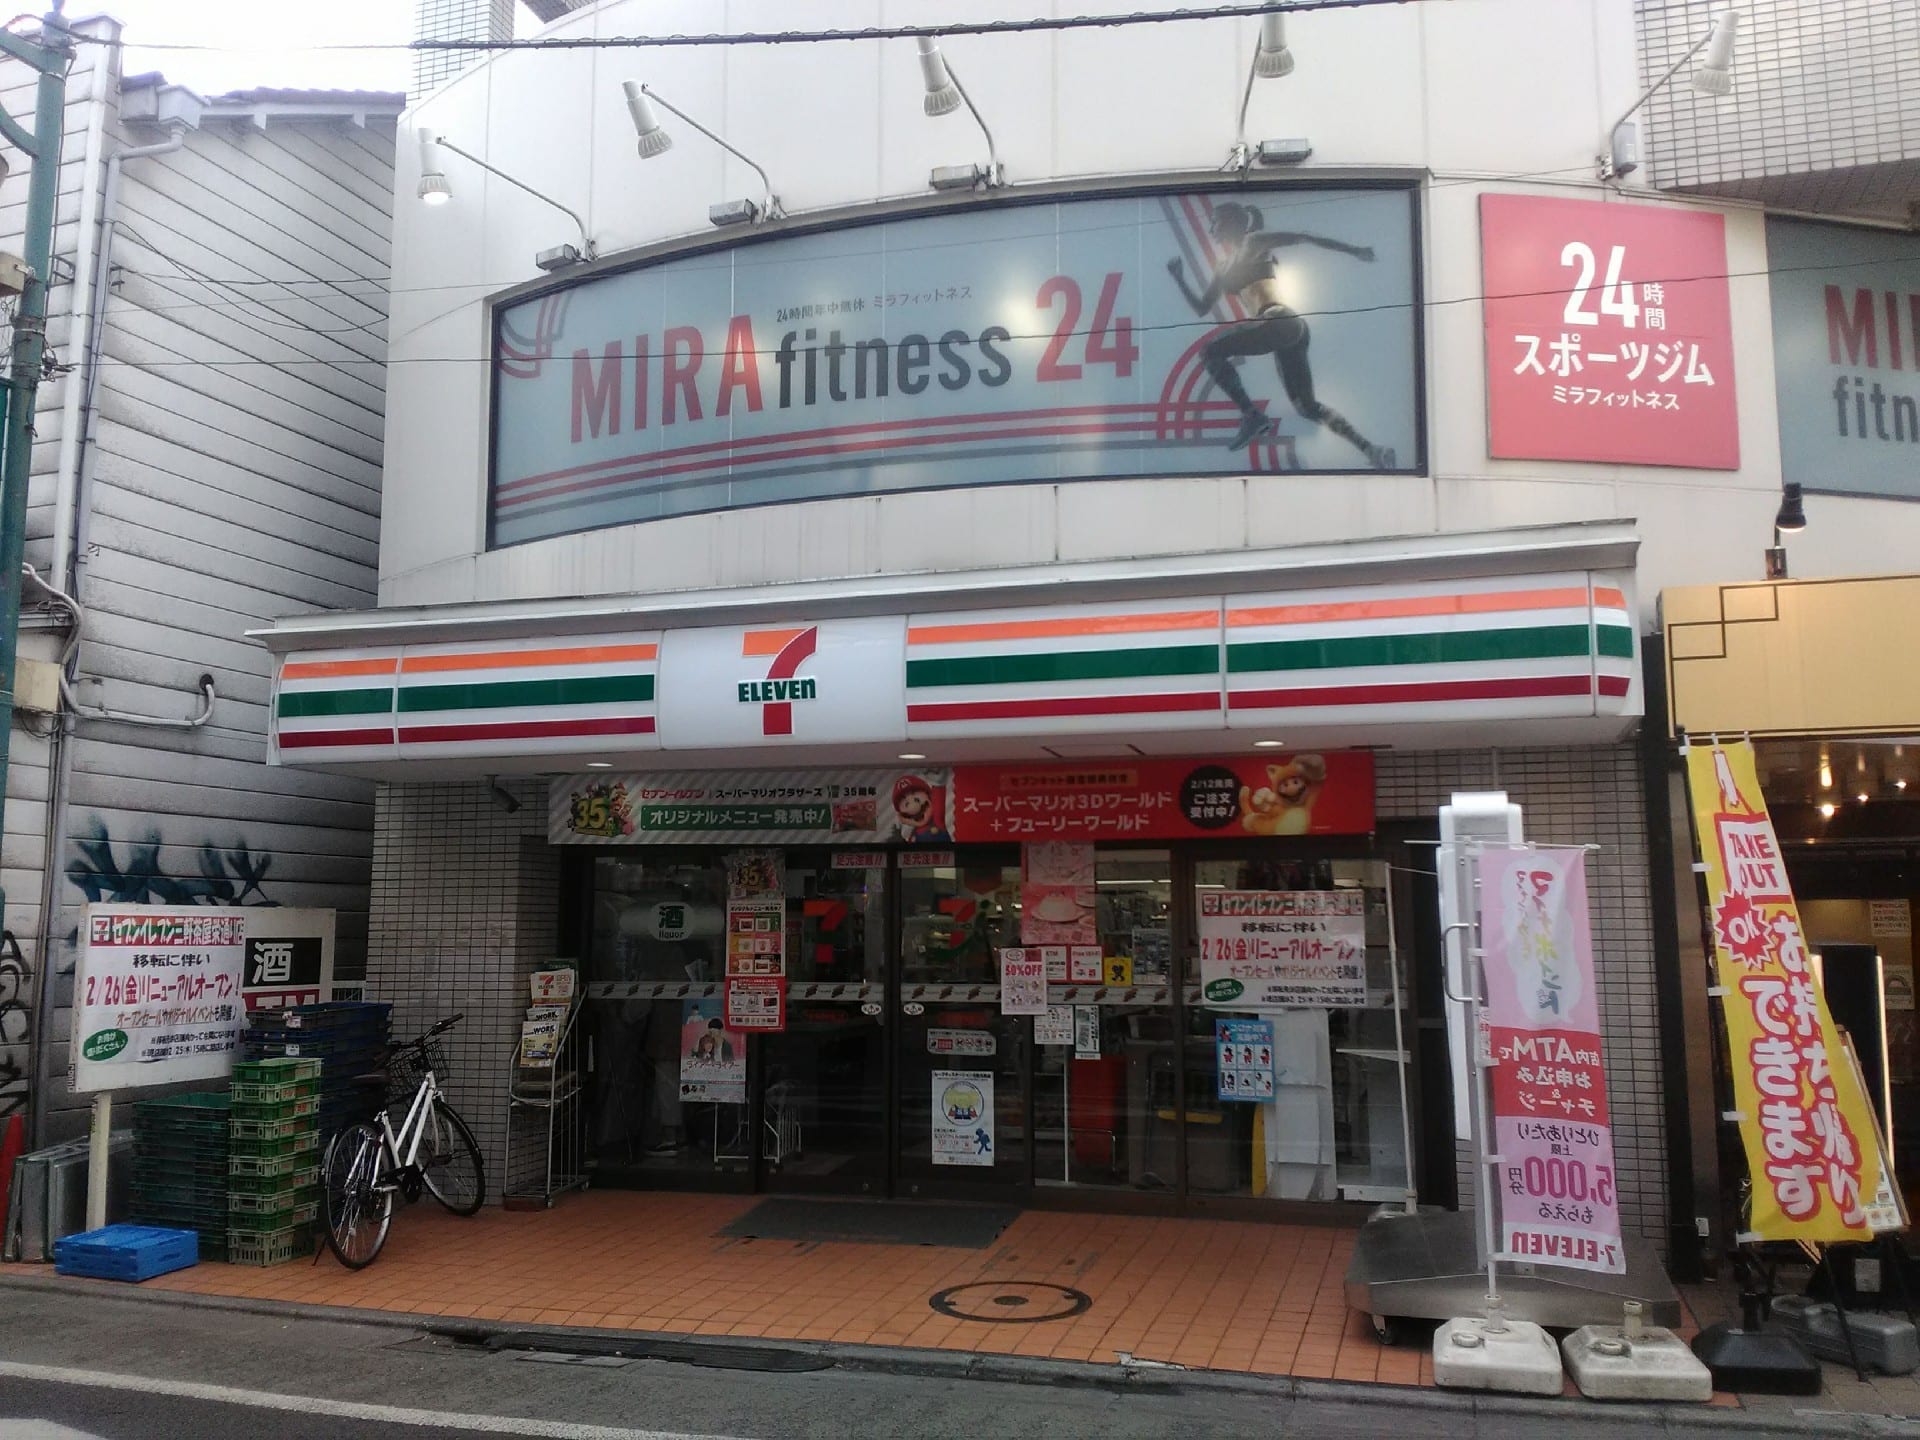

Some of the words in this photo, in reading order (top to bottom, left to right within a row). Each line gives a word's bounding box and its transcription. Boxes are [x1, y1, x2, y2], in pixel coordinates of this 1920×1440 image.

[776, 297, 865, 323] 24時間年中無休
[873, 285, 973, 308] ミラフィットネス
[1561, 241, 1639, 329] 24
[1643, 283, 1666, 331] 時間
[571, 314, 763, 443] MIRA
[775, 326, 1012, 409] fitness
[1036, 272, 1139, 382] 24
[1513, 333, 1716, 387] スポーツジム
[1552, 385, 1681, 411] ミラフィットネス
[742, 625, 818, 735] 7
[963, 792, 1173, 813] スーパーマリオ3Dワールド
[1192, 792, 1231, 804] ご注文
[1740, 863, 1779, 889] OUT
[658, 905, 685, 929] 酒
[132, 953, 212, 968] 移転に伴い
[251, 942, 294, 985] 酒
[1005, 964, 1042, 976] 50%OFF
[1742, 979, 1824, 1216] できます
